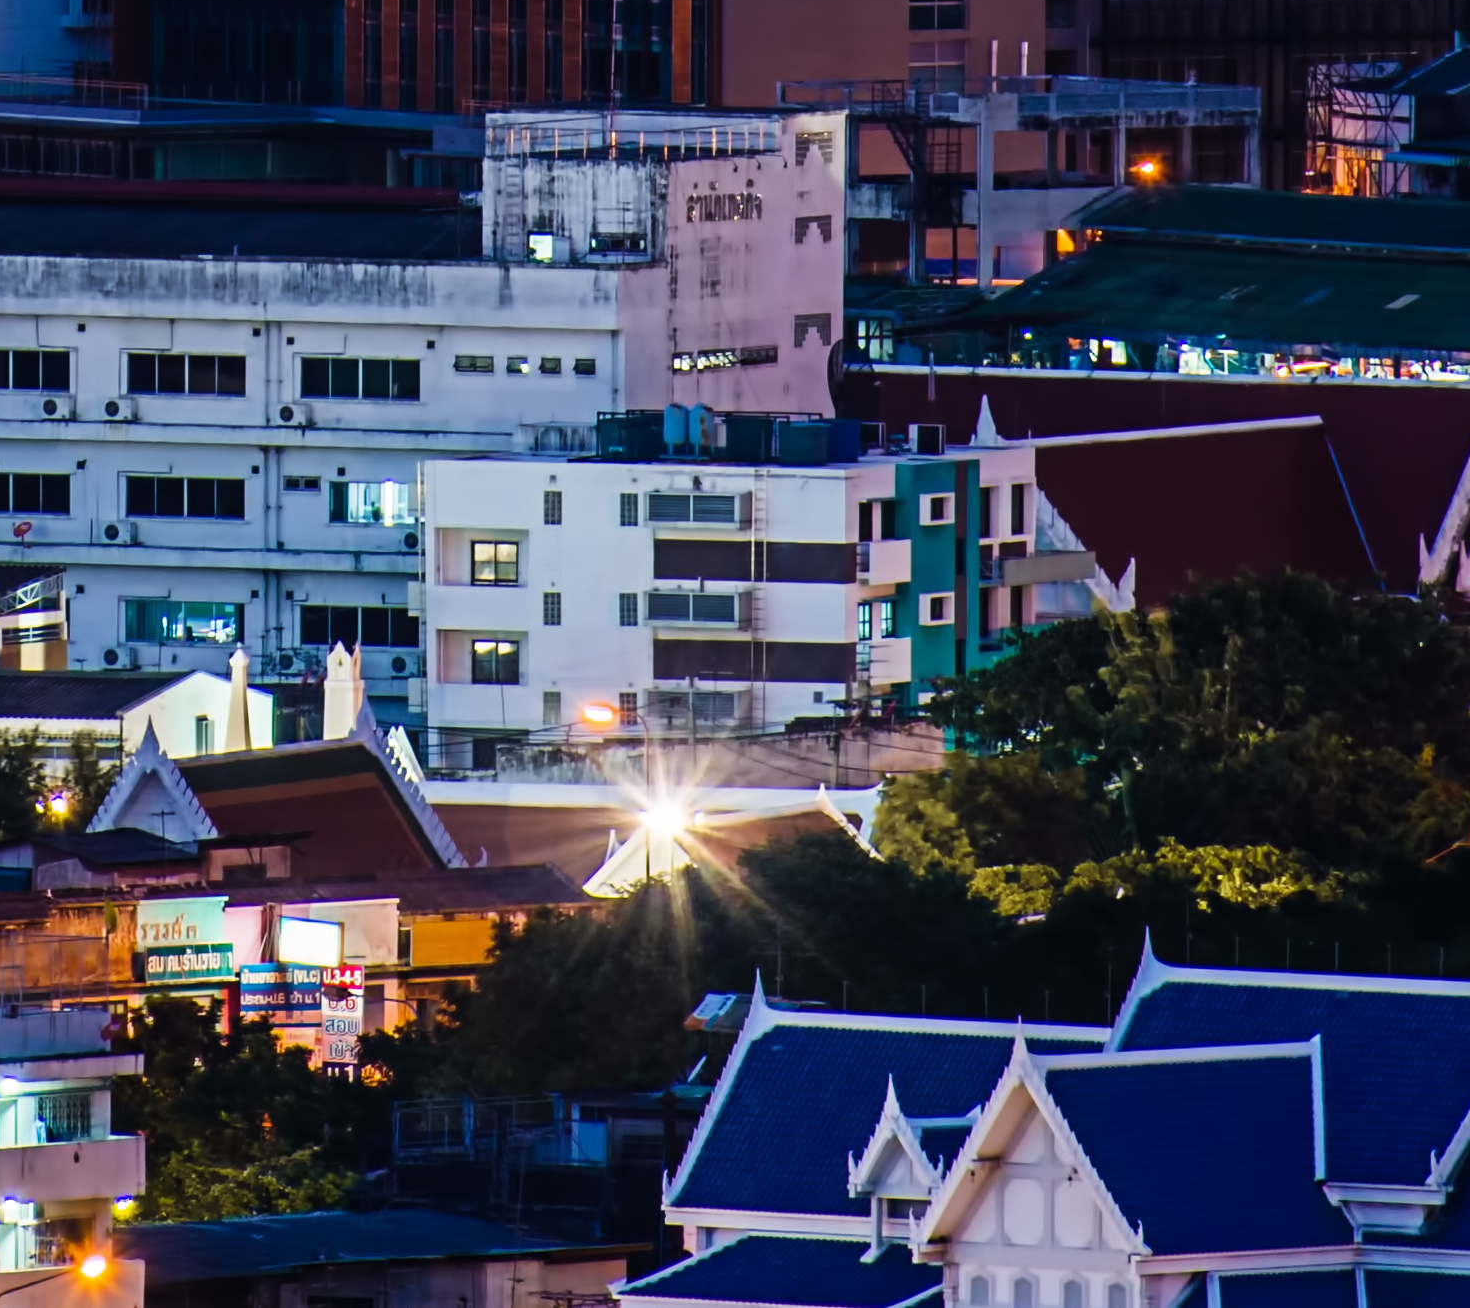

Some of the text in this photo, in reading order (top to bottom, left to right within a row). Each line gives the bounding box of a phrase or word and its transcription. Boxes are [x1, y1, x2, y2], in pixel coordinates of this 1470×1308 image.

[686, 179, 763, 222] สำนักเทศกิจ
[323, 968, 362, 985] ป.3-4-5
[324, 1018, 359, 1035] สอบ
[328, 1039, 356, 1059] เข้า
